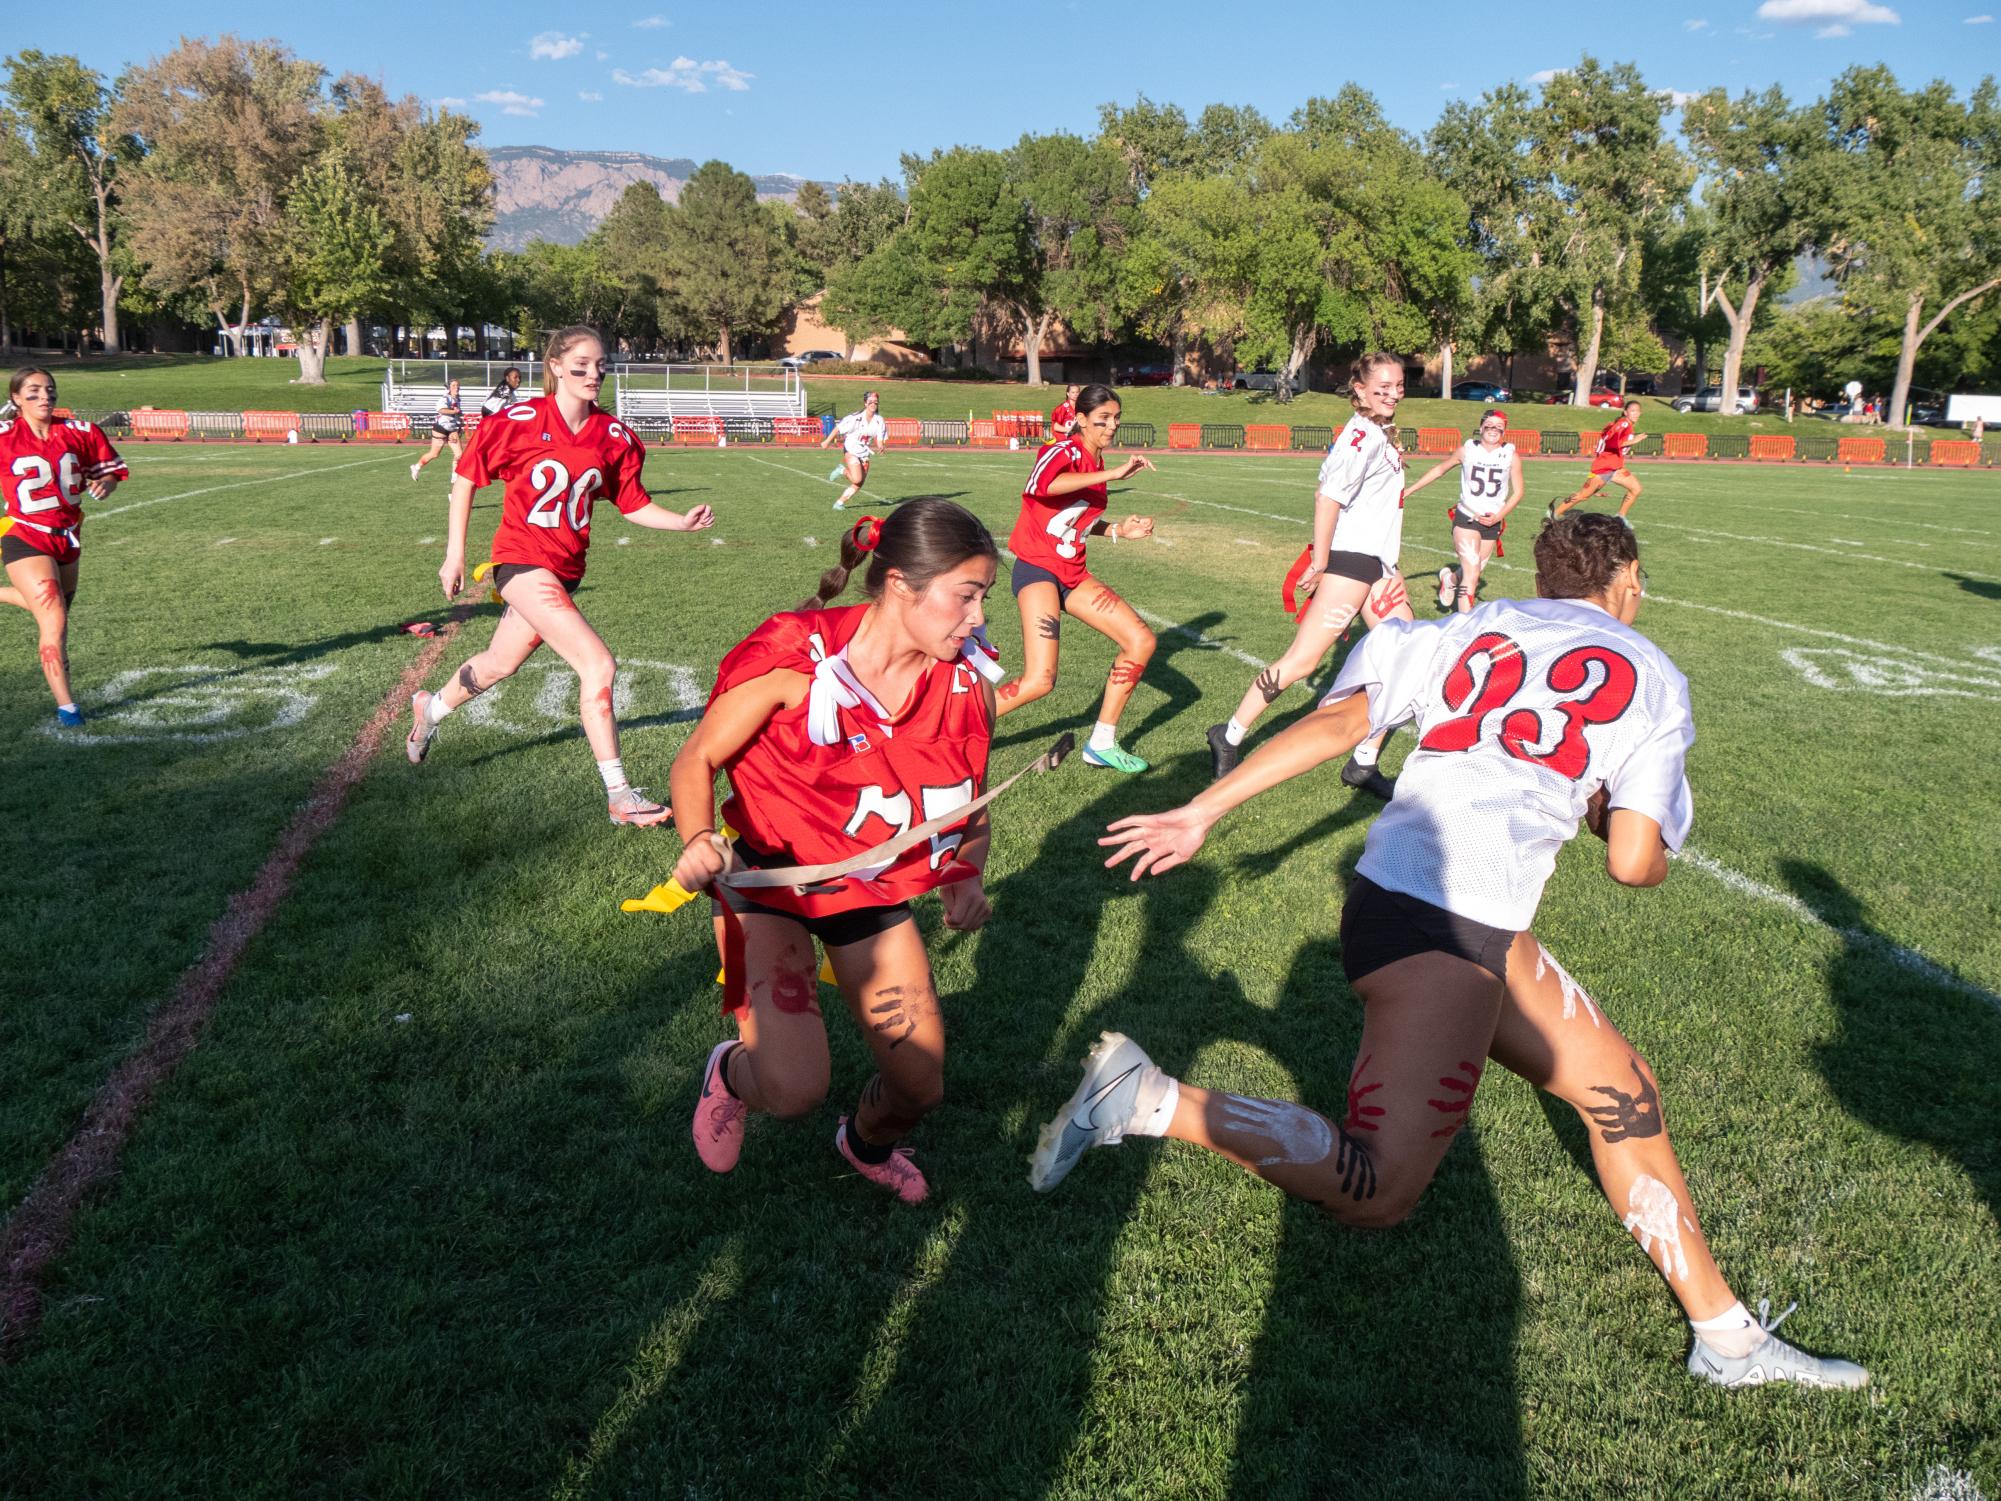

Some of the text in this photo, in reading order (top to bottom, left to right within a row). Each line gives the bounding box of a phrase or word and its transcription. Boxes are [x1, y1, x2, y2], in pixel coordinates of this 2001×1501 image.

[10, 452, 82, 516] 26
[526, 458, 603, 531] 20
[1470, 465, 1503, 498] 55
[1418, 631, 1638, 782] 23
